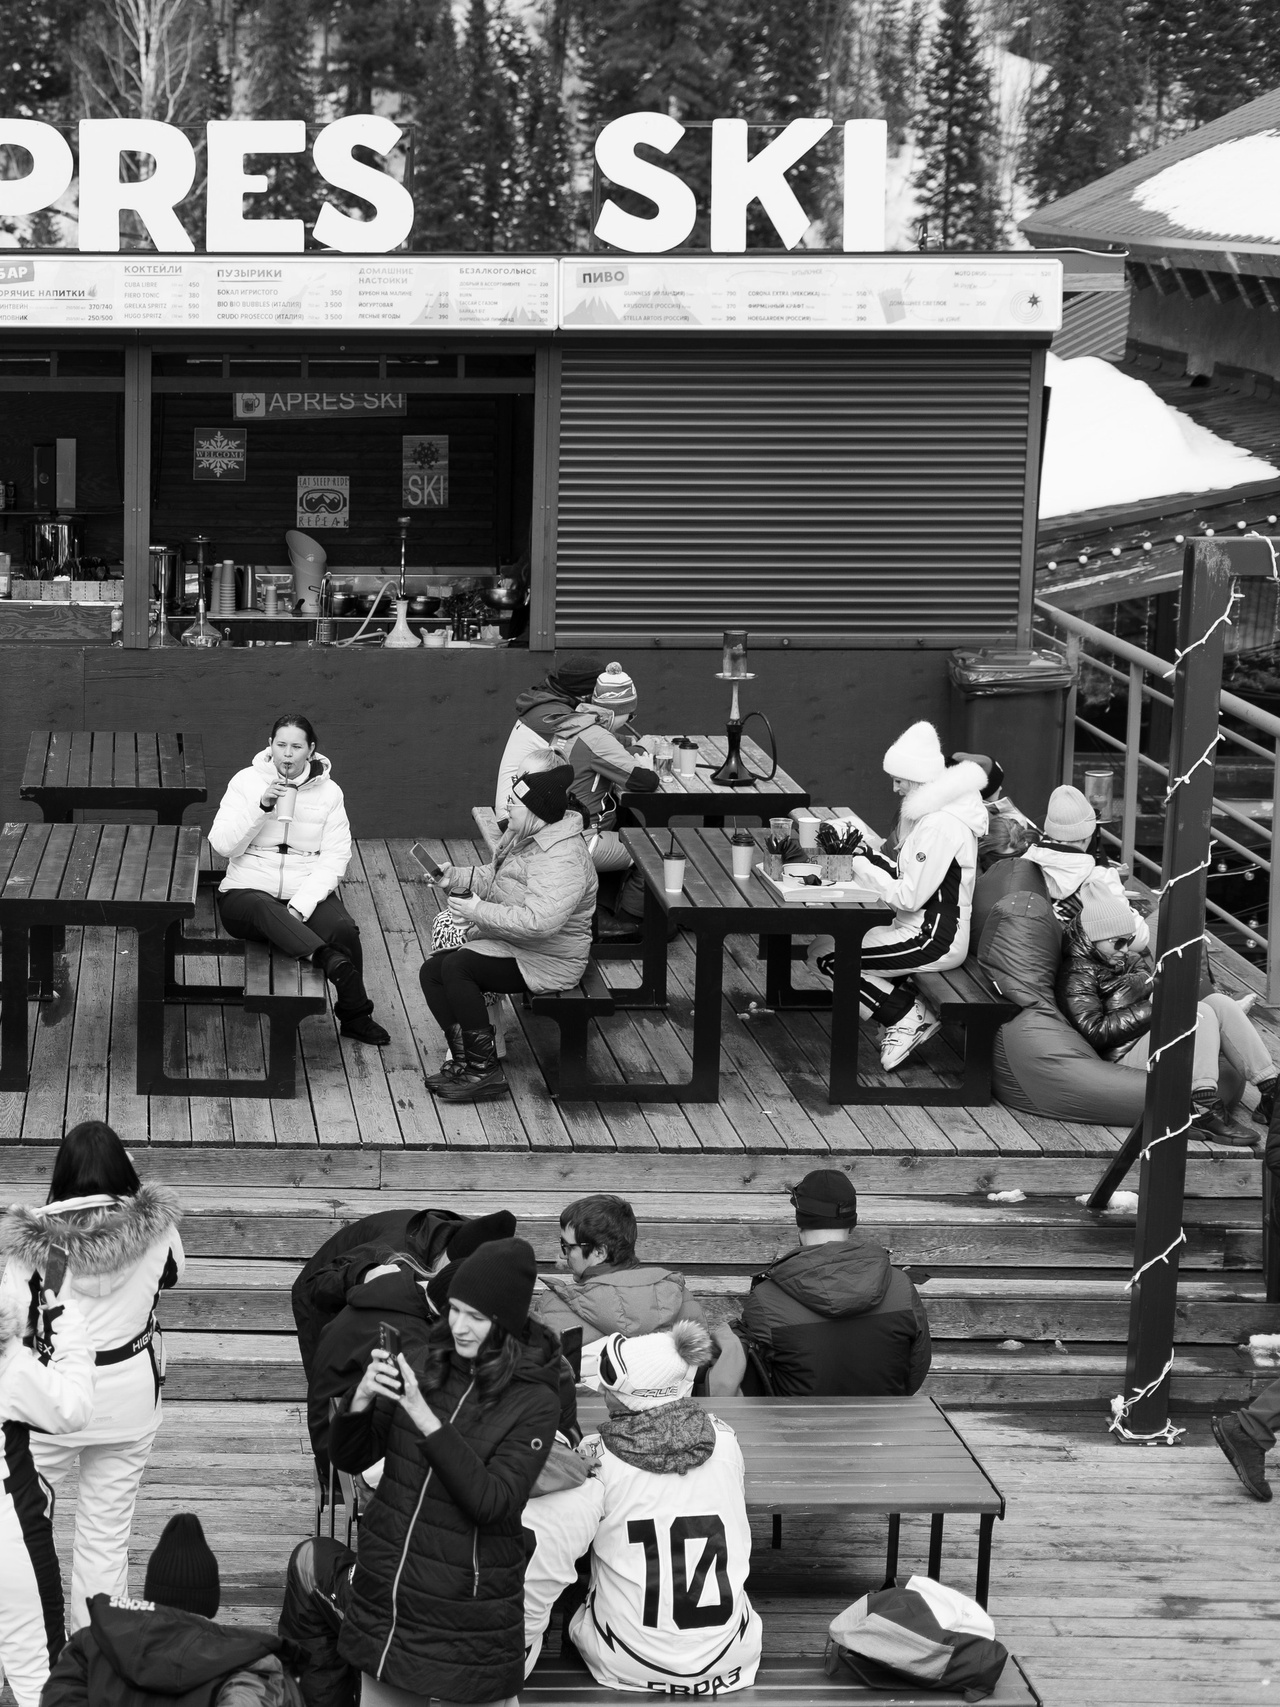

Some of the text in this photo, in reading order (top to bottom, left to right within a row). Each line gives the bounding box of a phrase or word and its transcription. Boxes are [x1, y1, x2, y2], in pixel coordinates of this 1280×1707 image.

[594, 113, 888, 252] SKI
[124, 264, 182, 273] КОКТЕЙЛИ
[359, 267, 414, 275] ДОМАШНИЕ
[217, 269, 282, 278] ПУЗЫРИКИ
[583, 271, 624, 284] ПИВО
[272, 300, 301, 309] (ИТАЛИЯ)
[275, 313, 304, 321] (ИТАЛИЯ)
[269, 393, 402, 411] APRES SKI
[299, 478, 348, 486] EAT SLEEP RIDE
[407, 475, 444, 505] SKI
[298, 516, 349, 526] REPEAT
[627, 1514, 734, 1630] 10
